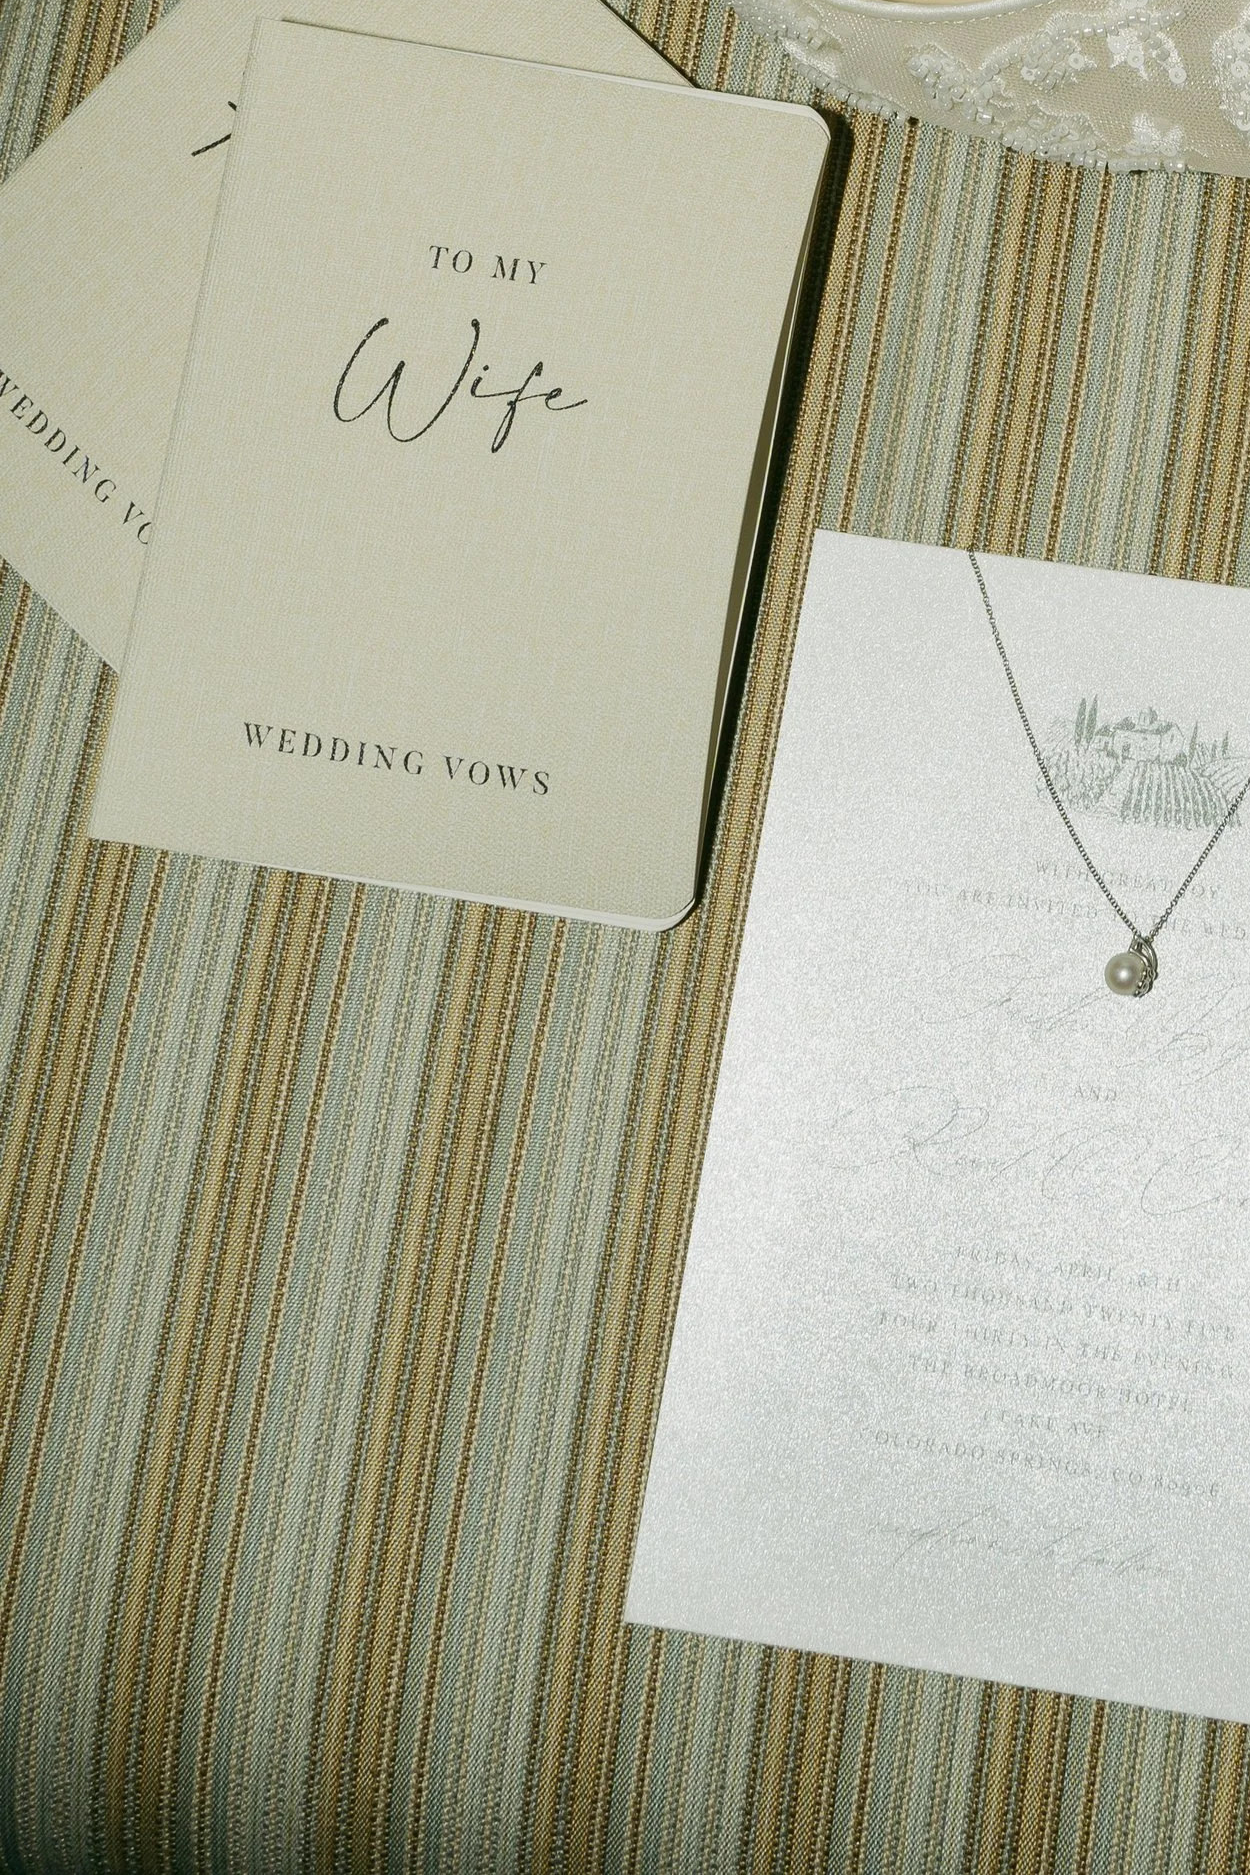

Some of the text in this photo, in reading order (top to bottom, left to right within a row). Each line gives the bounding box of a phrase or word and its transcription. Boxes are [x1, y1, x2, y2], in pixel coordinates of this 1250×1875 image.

[429, 245, 547, 285] TO MY
[333, 317, 589, 454] Wife
[243, 721, 551, 796] WEDDING VOWS
[957, 888, 994, 906] ARE
[1005, 893, 1099, 920] INVITED
[1072, 1085, 1118, 1103] AND
[963, 1363, 1107, 1400] BROADMOOR
